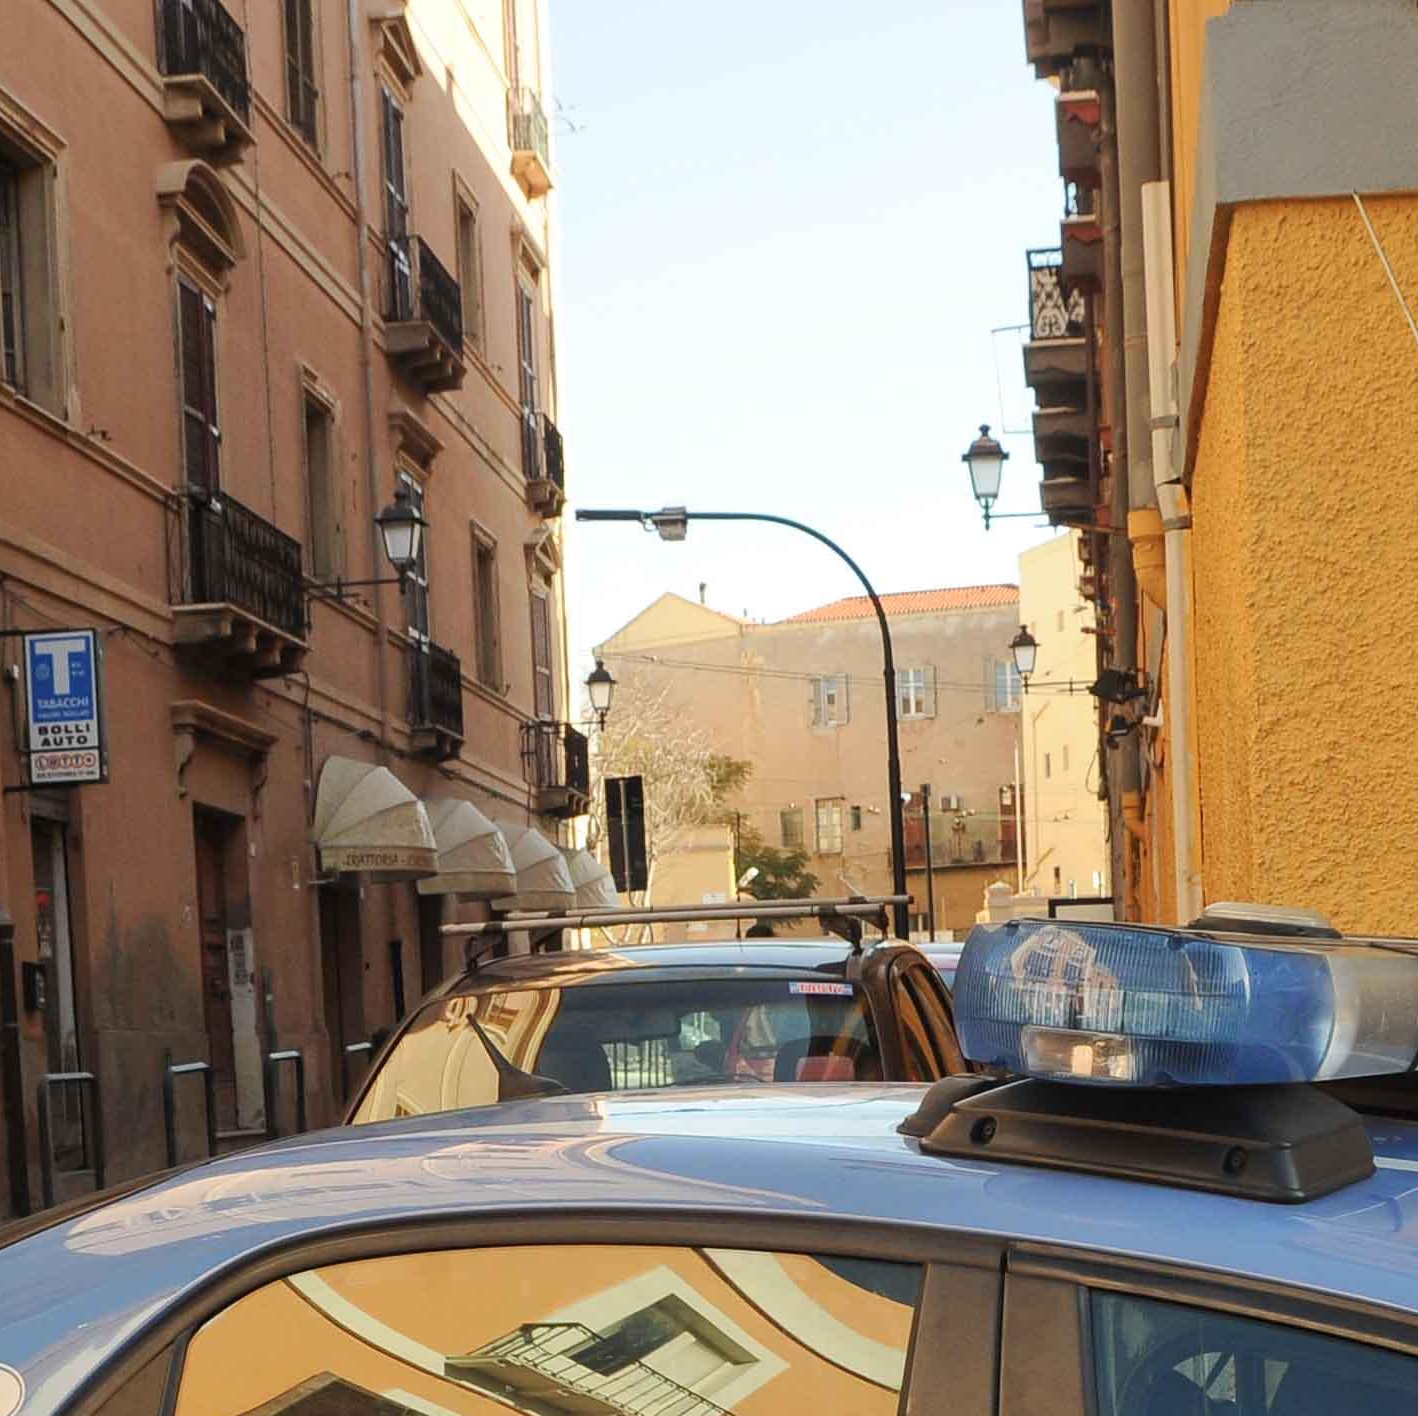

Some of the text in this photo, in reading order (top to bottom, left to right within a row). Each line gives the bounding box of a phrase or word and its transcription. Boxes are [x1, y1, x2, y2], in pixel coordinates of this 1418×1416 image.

[34, 639, 86, 695] T
[37, 696, 90, 710] TABACCHI
[37, 723, 90, 736] BOLLI
[40, 735, 88, 747] AUTO
